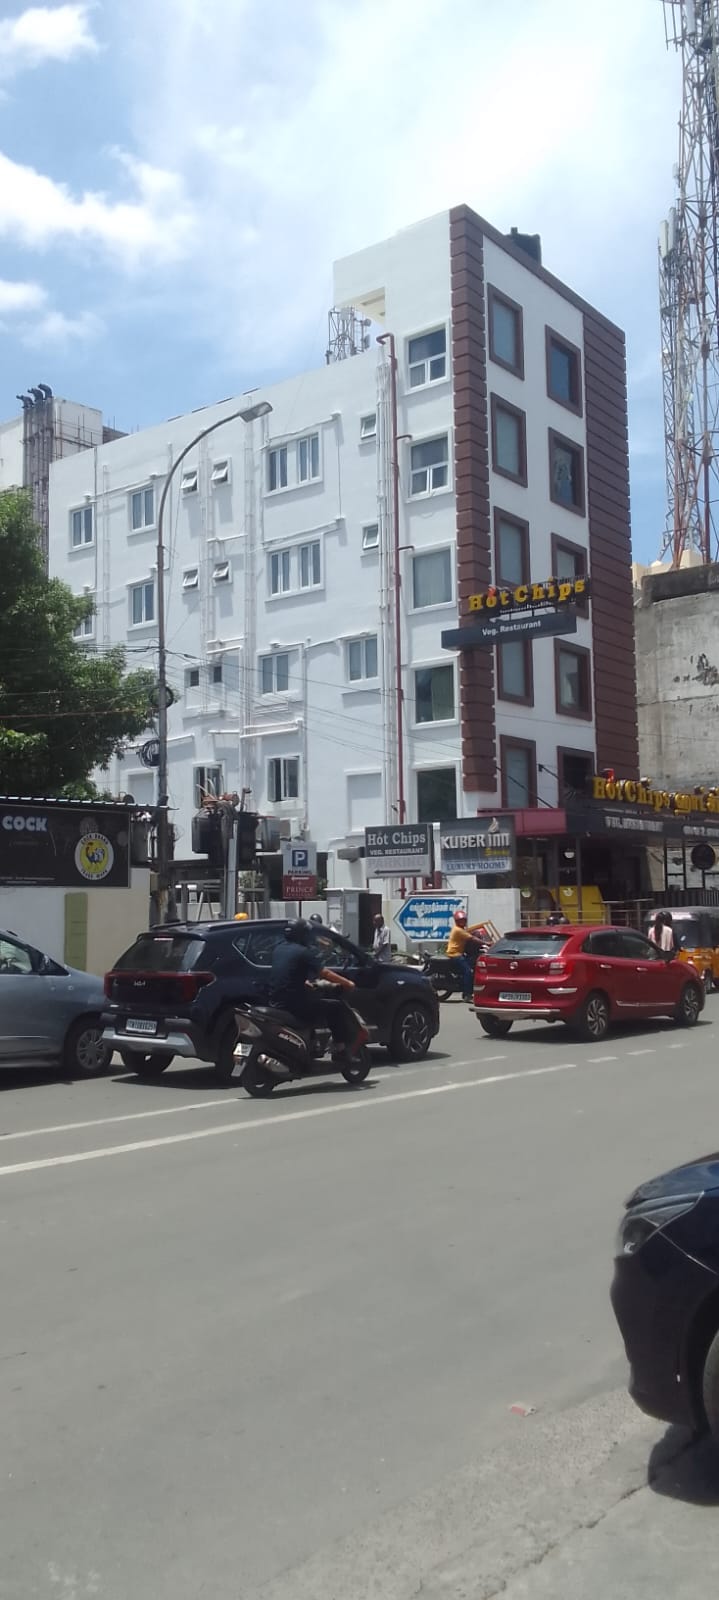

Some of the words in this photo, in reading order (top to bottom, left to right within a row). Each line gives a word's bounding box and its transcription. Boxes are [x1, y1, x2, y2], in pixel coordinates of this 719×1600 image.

[468, 590, 510, 611] Hot
[514, 577, 586, 602] Chips
[482, 627, 498, 636] Veg.
[500, 620, 541, 632] Restaurant
[592, 777, 623, 800] Hot
[624, 779, 670, 811] Chips
[2, 815, 48, 832] COCK
[367, 832, 389, 846] Hot
[392, 831, 426, 847] Chips
[440, 834, 486, 849] KUBER
[295, 851, 306, 866] P
[385, 847, 425, 855] RESTAURANT
[366, 856, 426, 869] PARKING
[446, 861, 476, 871] LUXURY
[478, 860, 506, 870] ROOMS
